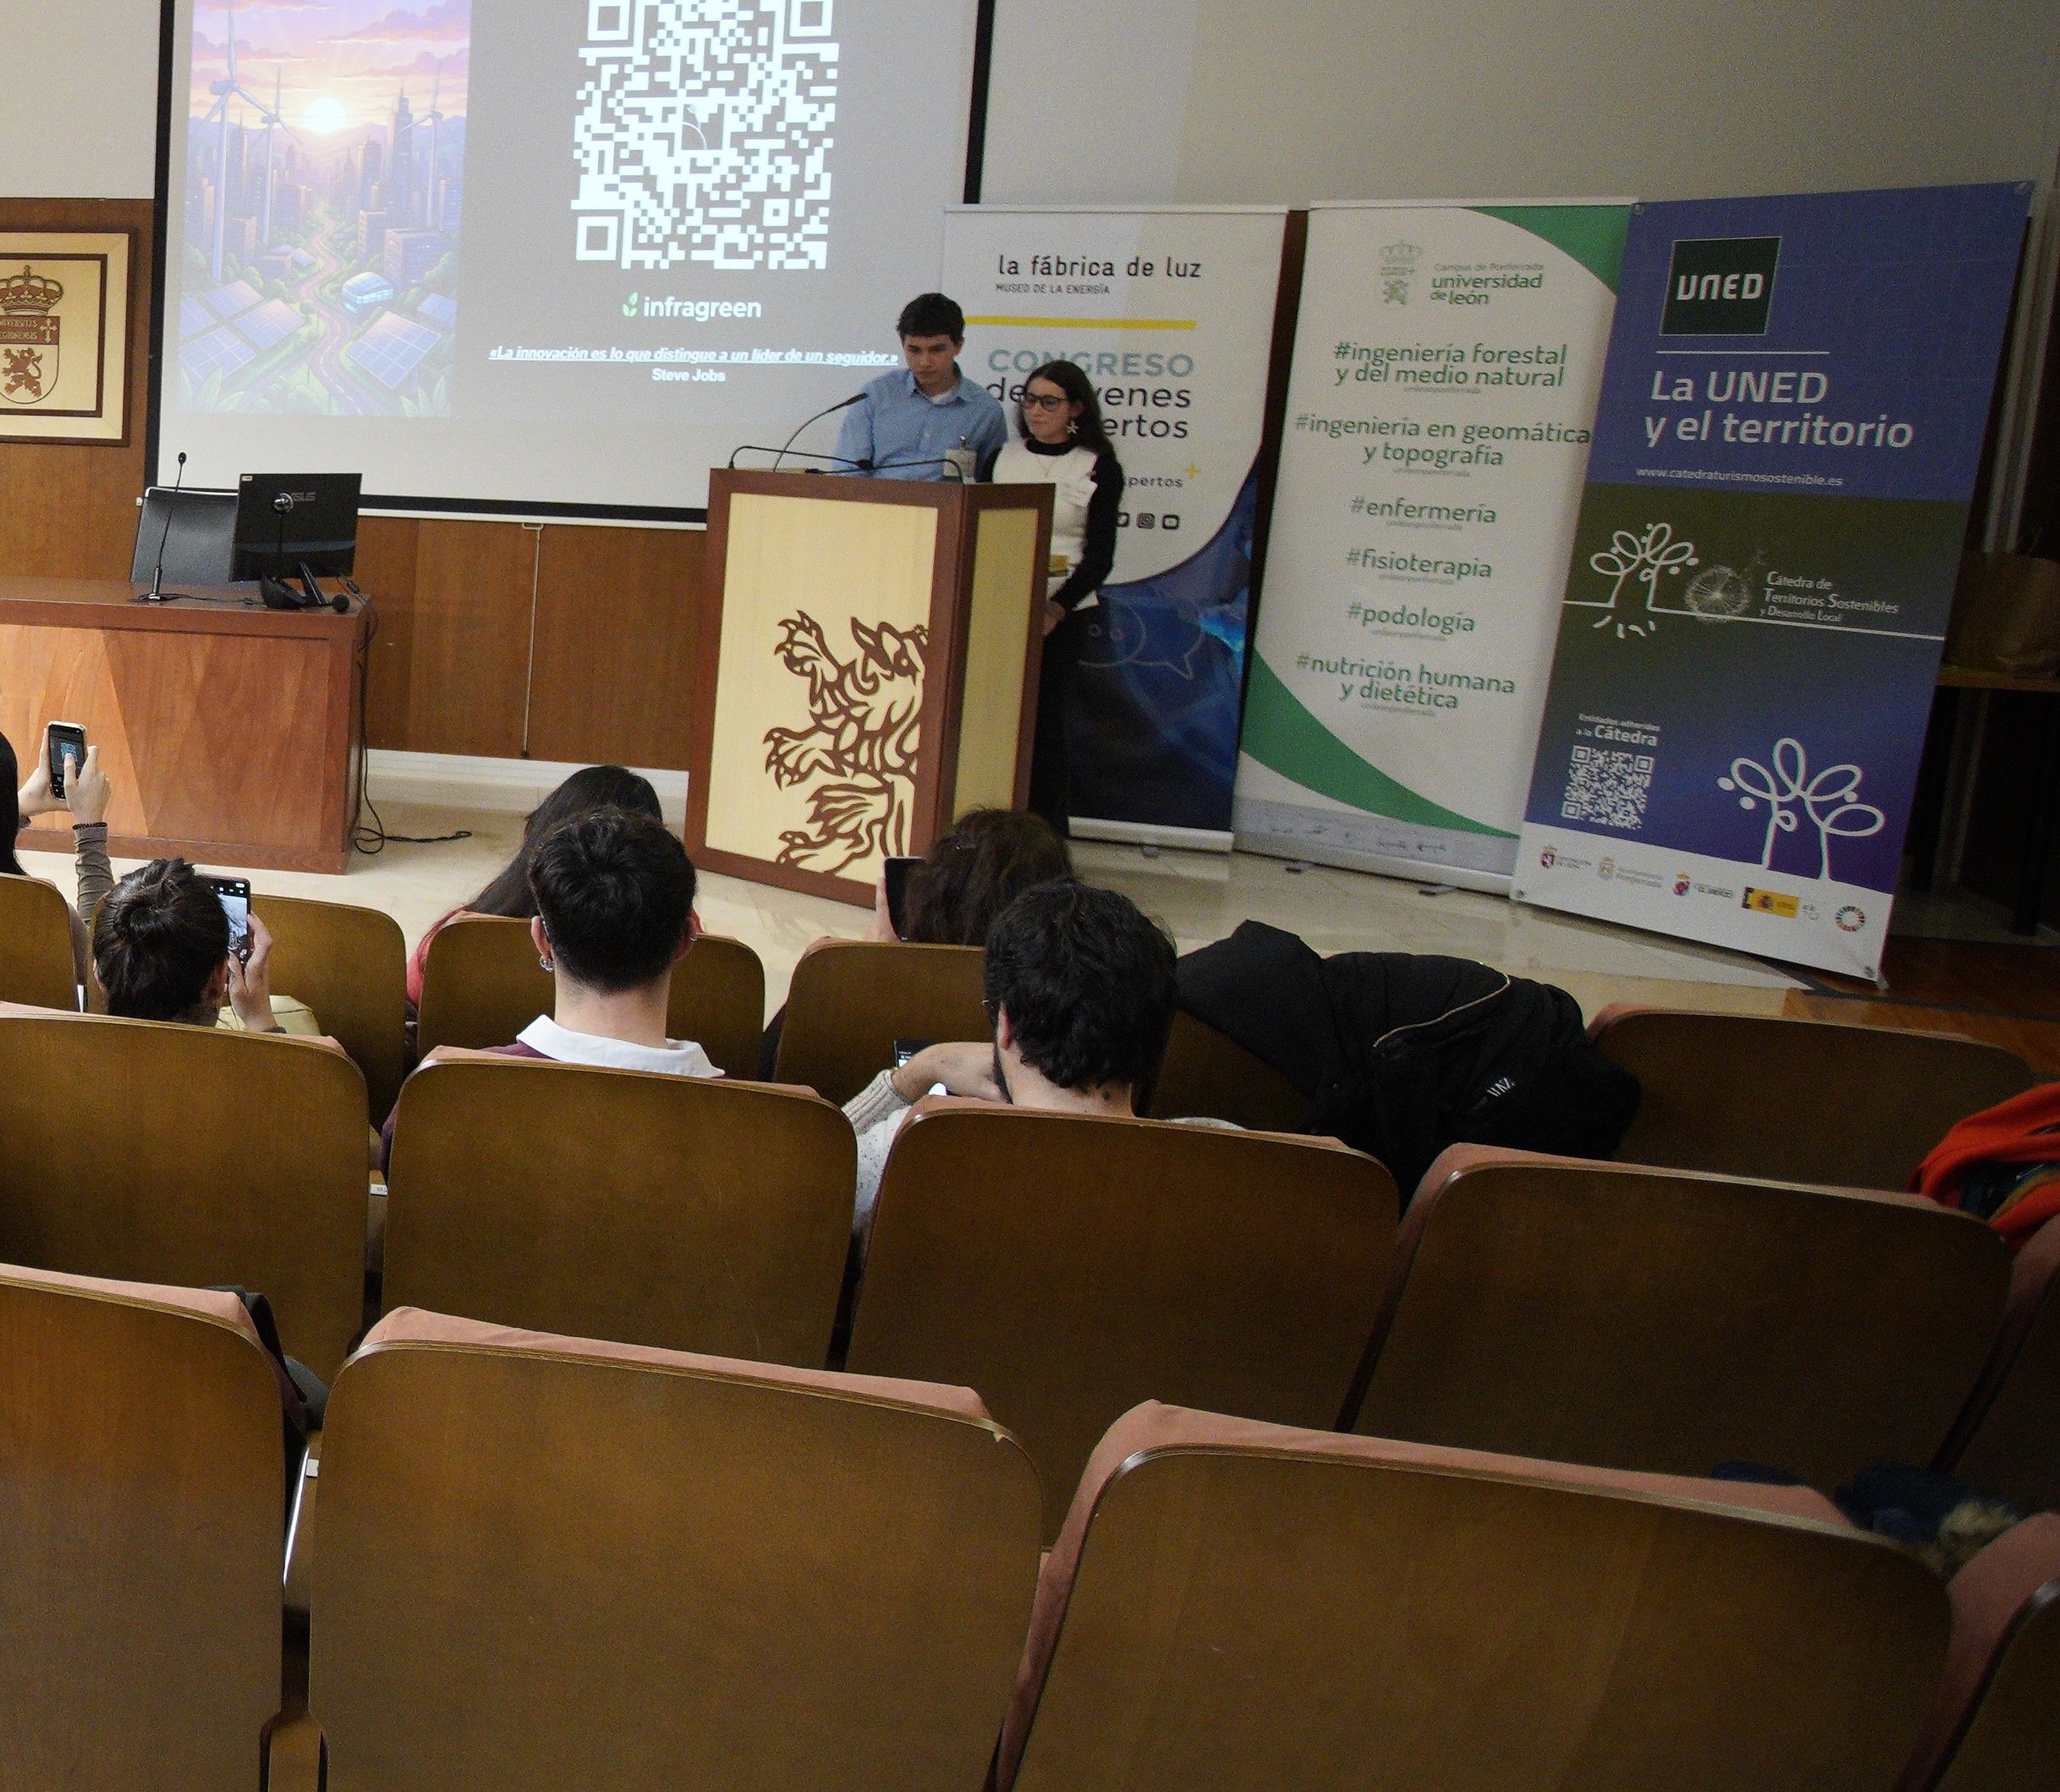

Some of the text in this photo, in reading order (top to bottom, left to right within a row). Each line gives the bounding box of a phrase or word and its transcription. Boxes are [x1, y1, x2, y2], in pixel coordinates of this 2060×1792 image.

[999, 254, 1202, 278] la fábrica de luz
[996, 284, 1029, 294] MUSEO
[1033, 284, 1046, 294] DE
[1050, 284, 1063, 294] LA
[1431, 273, 1543, 288] universidad
[1676, 273, 1764, 301] UNED
[644, 297, 761, 321] infragreen
[1448, 290, 1489, 305] león
[516, 346, 589, 360] innovación
[590, 349, 607, 360] es
[610, 347, 624, 361] lo
[626, 350, 652, 363] que
[653, 348, 717, 364] distingue
[718, 352, 728, 362] a
[730, 351, 749, 362] un
[785, 349, 803, 362] de
[805, 351, 824, 363] un
[1334, 341, 1567, 367] #ingeniería forestal
[652, 367, 726, 382] Steve Jobs
[1334, 362, 1566, 388] y del medio natural
[1652, 370, 1830, 404] La UNED
[987, 377, 1025, 403] de
[1103, 414, 1188, 438] ertos
[1294, 414, 1591, 444] #ingeniería en geomática
[1645, 410, 1914, 449] y el territorio
[1362, 442, 1503, 469] y topografía
[1127, 476, 1183, 489] pertos
[1636, 468, 1843, 486] www.catedraturismosostenible.es
[1350, 495, 1498, 524] #enfermería
[1345, 548, 1493, 580] #fisioterapia
[1816, 578, 1833, 590] de
[1763, 588, 1899, 614] Territorios Sostenibles
[1346, 602, 1477, 635] #podología
[1296, 652, 1516, 694] #nutrición humana
[1339, 681, 1354, 702] y
[1361, 681, 1459, 709] dietética
[1594, 724, 1658, 747] Cátedra
